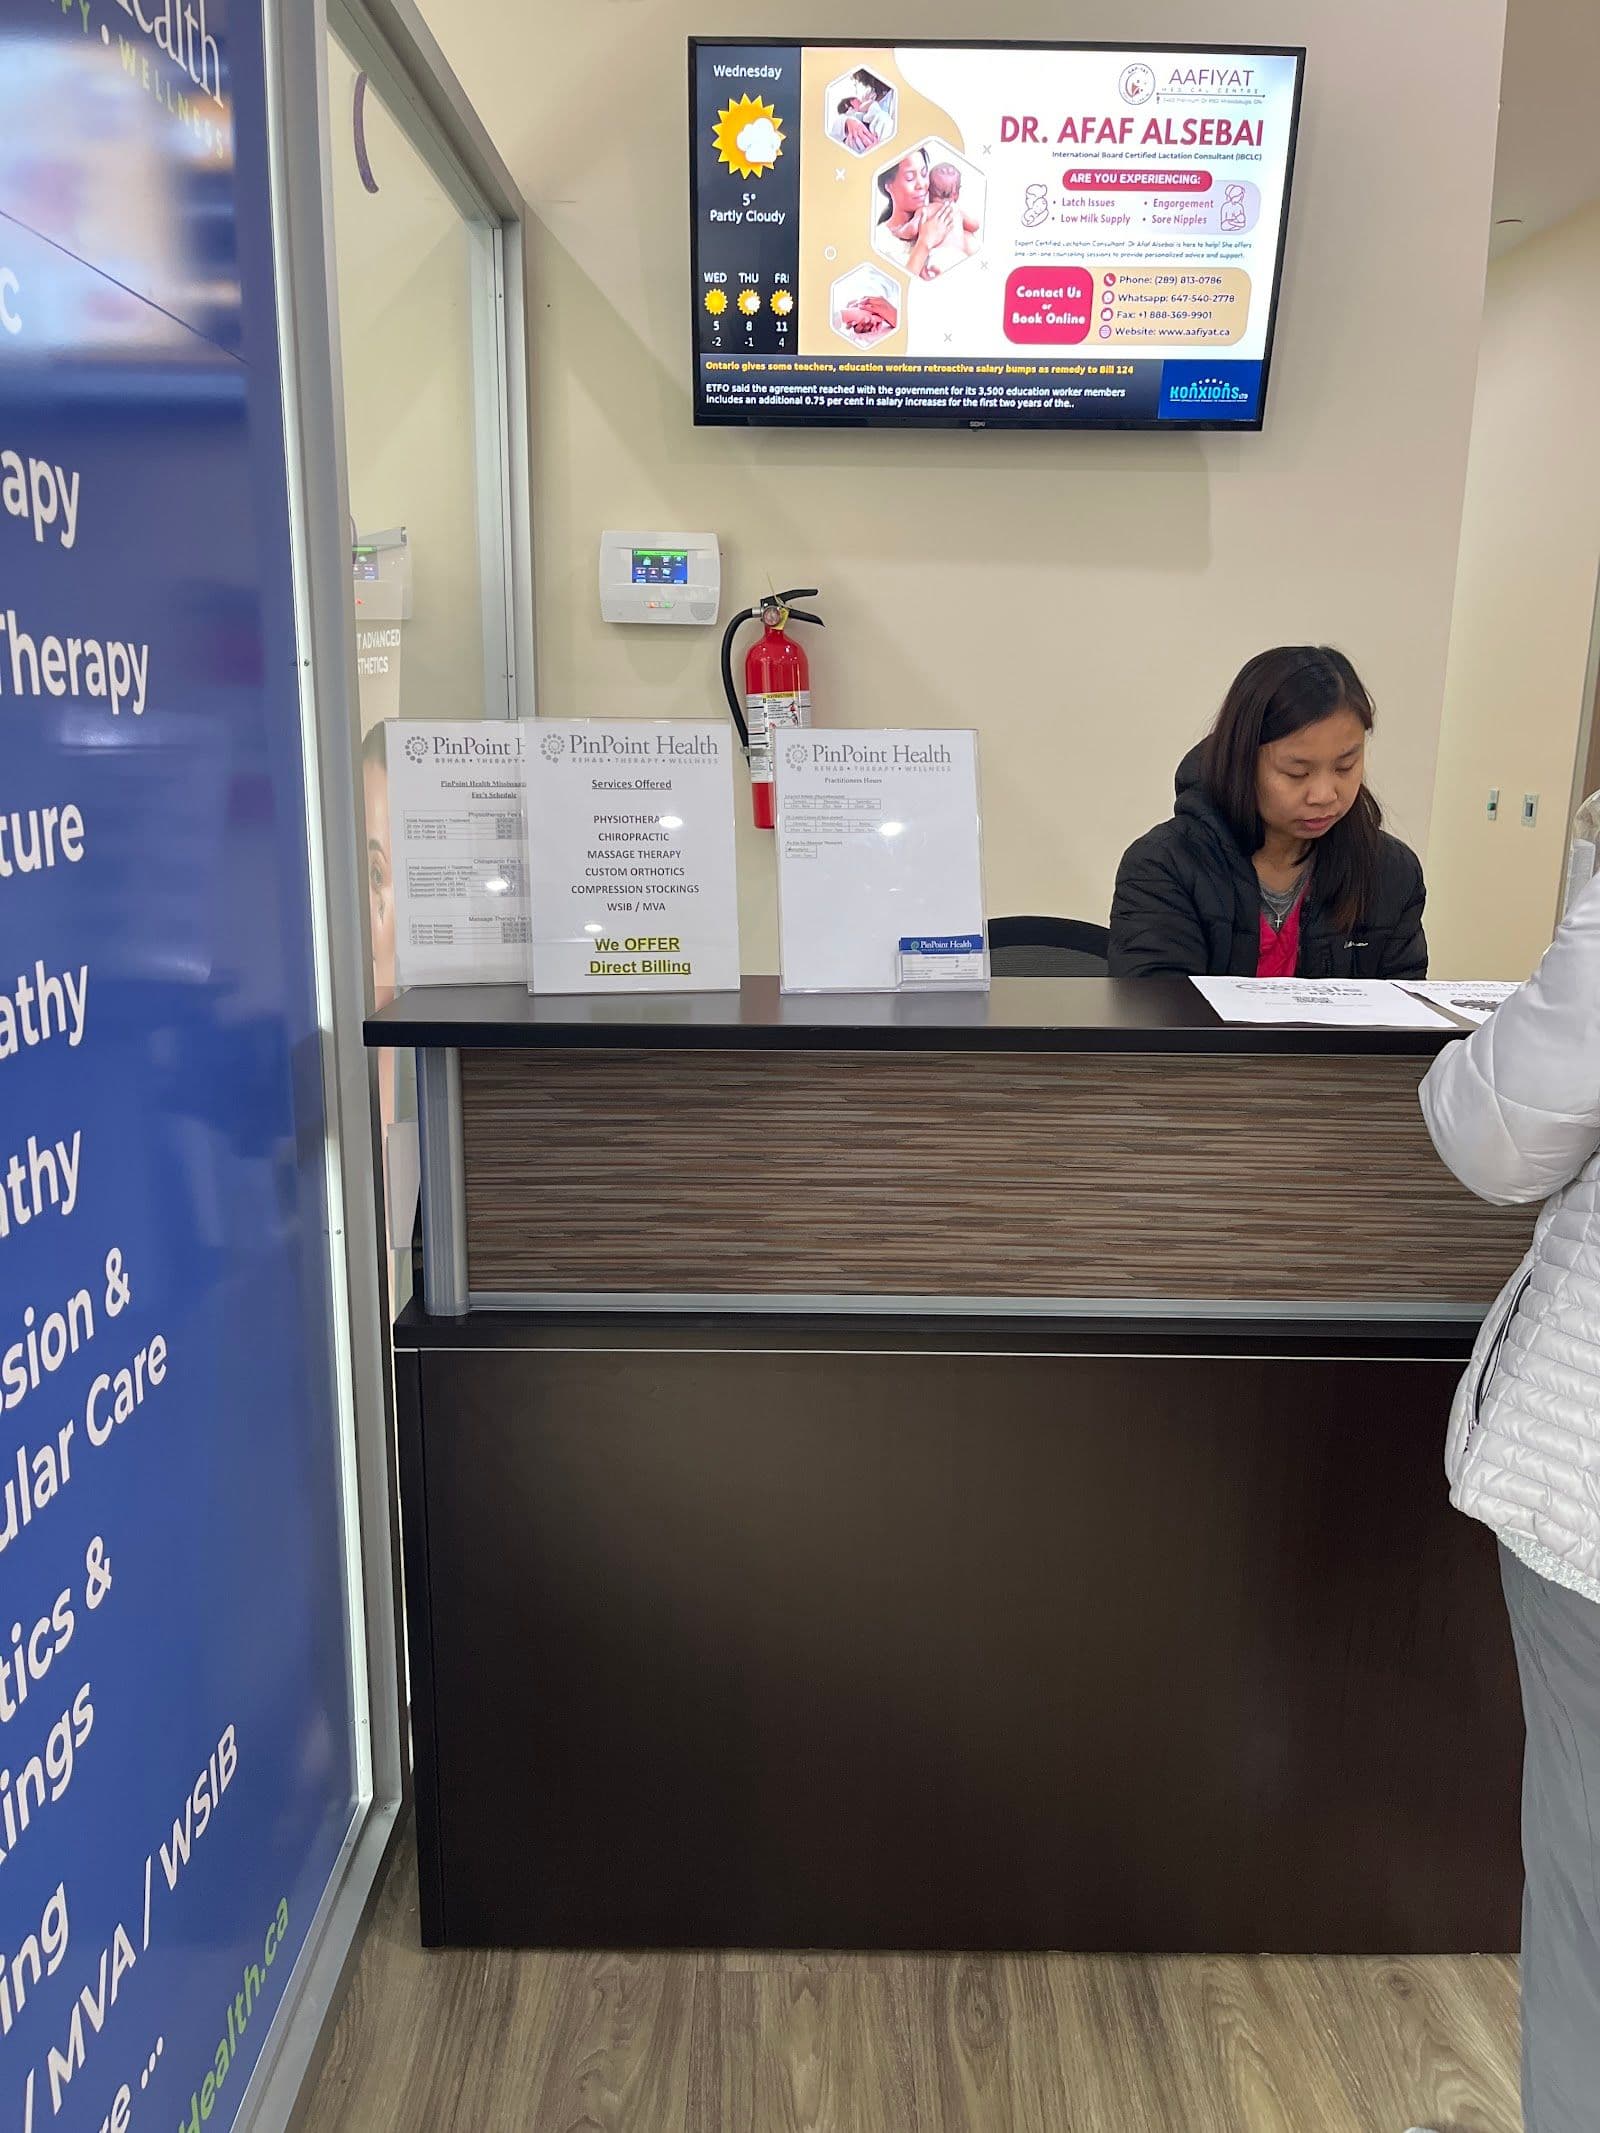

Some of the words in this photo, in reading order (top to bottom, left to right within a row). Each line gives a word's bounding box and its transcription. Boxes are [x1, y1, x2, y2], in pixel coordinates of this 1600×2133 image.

[713, 65, 782, 80] Wednesday
[1168, 69, 1255, 87] AAFIYAT
[1000, 115, 1048, 143] DR.
[1057, 117, 1134, 145] AFAF
[1140, 118, 1264, 146] ALSEBAI
[1052, 151, 1100, 159] International
[1101, 151, 1123, 159] Board
[1125, 151, 1157, 160] Certified
[1158, 152, 1193, 160] Lactation
[1194, 152, 1234, 161] Consultant
[1070, 174, 1091, 184] ARE
[1094, 174, 1118, 184] YOU
[1119, 174, 1201, 185] EXPERIENCING:
[1062, 198, 1086, 208] Latch
[1088, 198, 1115, 208] Issues
[1153, 198, 1214, 210] Engorgement
[709, 209, 743, 225] Partly
[745, 210, 785, 225] Cloudy
[1060, 214, 1078, 223] Low
[1080, 214, 1099, 224] Milk
[1100, 214, 1131, 226] Supply
[1152, 214, 1172, 224] Sore
[1173, 214, 1208, 226] Nipples
[703, 272, 728, 283] WED
[738, 272, 759, 283] THU
[774, 273, 790, 284] FRI
[1119, 275, 1153, 285] Phone:
[1154, 275, 1178, 286] (289)
[1016, 286, 1064, 299] Contact
[1067, 287, 1082, 299] Us
[1118, 294, 1168, 305] Whatsapp:
[1012, 312, 1043, 325] Book
[1045, 313, 1086, 325] Online
[1116, 311, 1136, 319] Fax:
[713, 321, 720, 331] 5
[745, 321, 753, 331] 8
[775, 321, 788, 332] 11
[1115, 327, 1156, 336] Website:
[1158, 328, 1231, 338] www.aafiyat.ca
[711, 337, 722, 347] -2
[744, 337, 754, 347] -1
[778, 338, 785, 347] 4
[706, 361, 740, 371] Ontario
[742, 362, 766, 373] gives
[767, 363, 793, 372] some
[794, 362, 837, 373] teachers,
[838, 362, 884, 372] education
[885, 363, 922, 373] workers
[924, 363, 974, 373] retroactive
[976, 364, 1003, 375] salary
[1005, 364, 1037, 376] bumps
[1038, 366, 1049, 374] as
[1051, 365, 1086, 376] remedy
[1087, 365, 1098, 374] to
[1116, 365, 1134, 374] 124
[706, 384, 730, 393] ETFO
[731, 384, 750, 393] said
[752, 384, 768, 393] the
[769, 385, 818, 396] agreement
[819, 385, 855, 394] reached
[857, 385, 877, 394] with
[878, 385, 894, 394] the
[895, 386, 949, 397] government
[950, 386, 963, 396] for
[965, 386, 976, 396] its
[978, 386, 1004, 397] 3,500
[1006, 386, 1050, 396] education
[1052, 387, 1082, 397] worker
[1083, 387, 1125, 397] members
[706, 394, 744, 404] includes
[745, 396, 757, 404] an
[758, 395, 803, 405] additional
[804, 396, 825, 405] 0.75
[827, 397, 842, 407] per
[843, 396, 864, 405] cent
[865, 396, 875, 406] in
[876, 396, 902, 408] salary
[904, 397, 947, 407] increases
[948, 397, 961, 407] for
[962, 398, 978, 407] the
[979, 398, 998, 408] first
[999, 399, 1015, 408] two
[1017, 399, 1042, 409] years
[1043, 398, 1054, 408] of
[1, 450, 80, 549] apy
[363, 628, 400, 649] ADVANCED
[433, 737, 511, 755] PinPoint
[569, 734, 650, 755] PinPoint
[656, 734, 719, 755] Health
[812, 744, 890, 763] PinPoint
[893, 744, 952, 763] Health
[592, 779, 633, 790] Services
[635, 779, 672, 790] Offered
[593, 815, 663, 824] PHYSIOTHERA
[598, 833, 670, 841] CHIROPRACTIC
[587, 850, 635, 859] MASSAGE
[638, 850, 681, 859] THERAPY
[585, 867, 628, 876] CUSTOM
[630, 867, 685, 876] ORTHOTICS
[571, 885, 643, 894] COMPRESSION
[645, 885, 700, 894] STOCKINGS
[607, 903, 633, 911] WSIB
[643, 903, 666, 911] MVA
[595, 939, 620, 951] We
[624, 937, 680, 951] OFFER
[949, 940, 972, 948] Health
[590, 960, 637, 974] Direct
[642, 960, 692, 975] Billing
[0, 1288, 94, 1416] sion
[105, 1247, 130, 1318] &
[86, 1334, 167, 1446] Care
[86, 1535, 112, 1610] &
[0, 1682, 94, 1867] ings
[47, 1923, 137, 2115] MVA
[159, 1724, 239, 1891] WSIB
